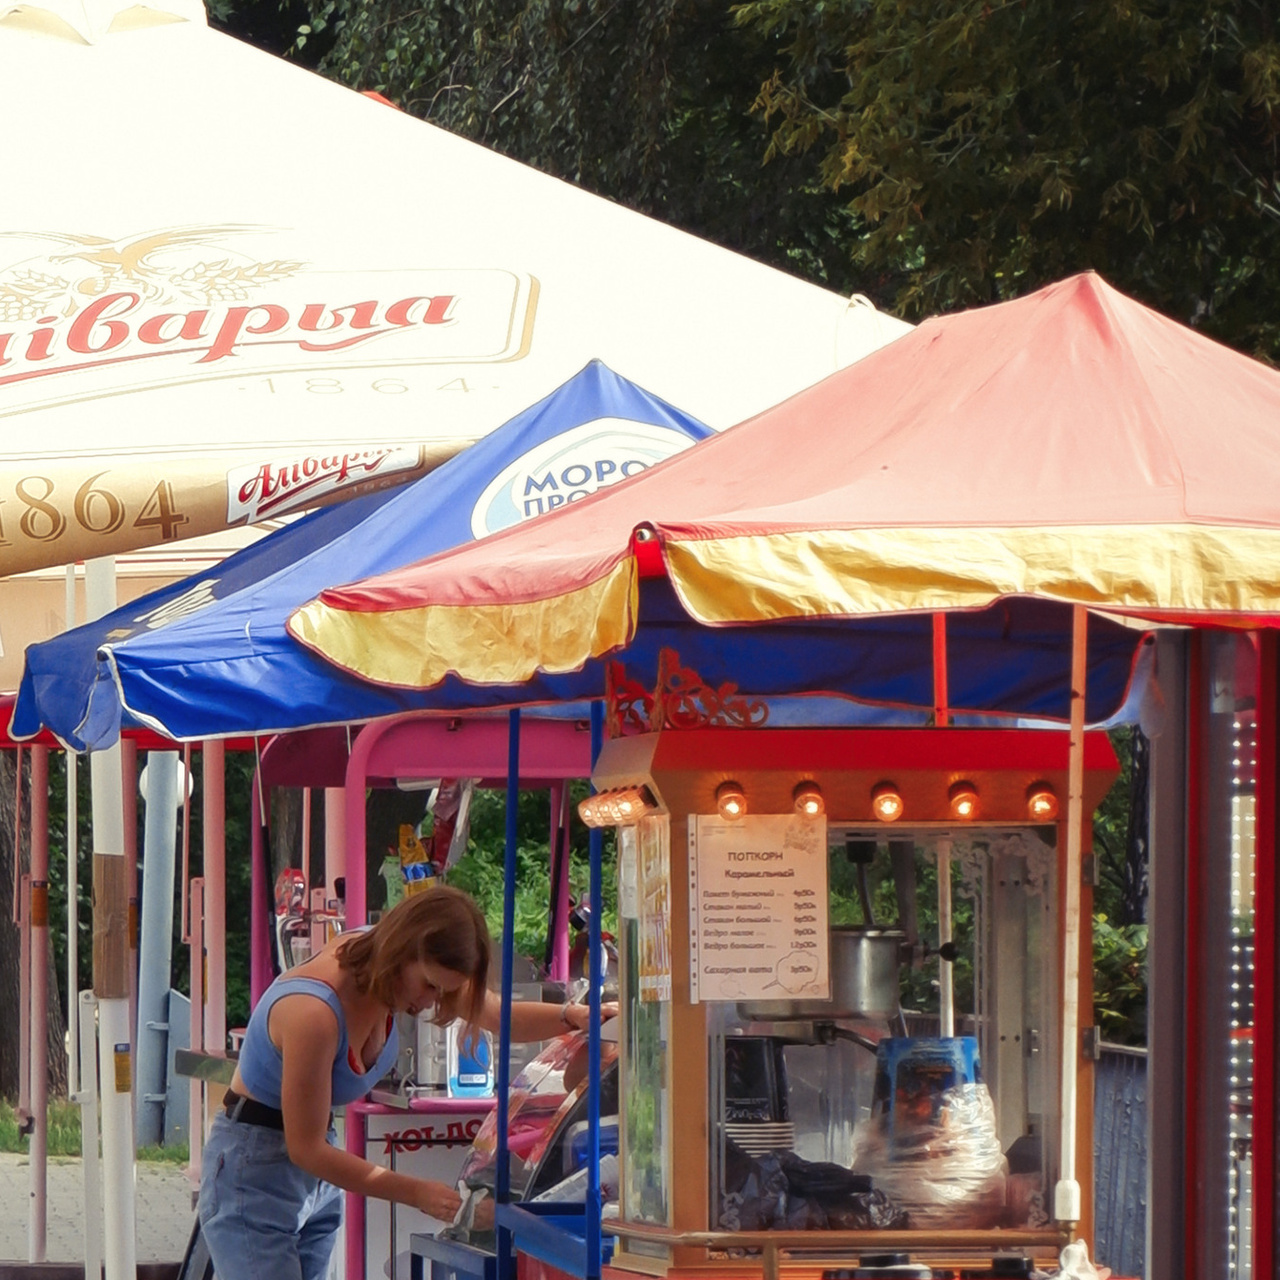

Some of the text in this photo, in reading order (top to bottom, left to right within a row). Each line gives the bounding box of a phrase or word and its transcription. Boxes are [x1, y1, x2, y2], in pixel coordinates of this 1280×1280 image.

[258, 375, 475, 396] 1864
[523, 459, 649, 497] МОРО
[728, 851, 783, 861] ПОПКОРН
[383, 1118, 483, 1154] ХОТ-ДО
